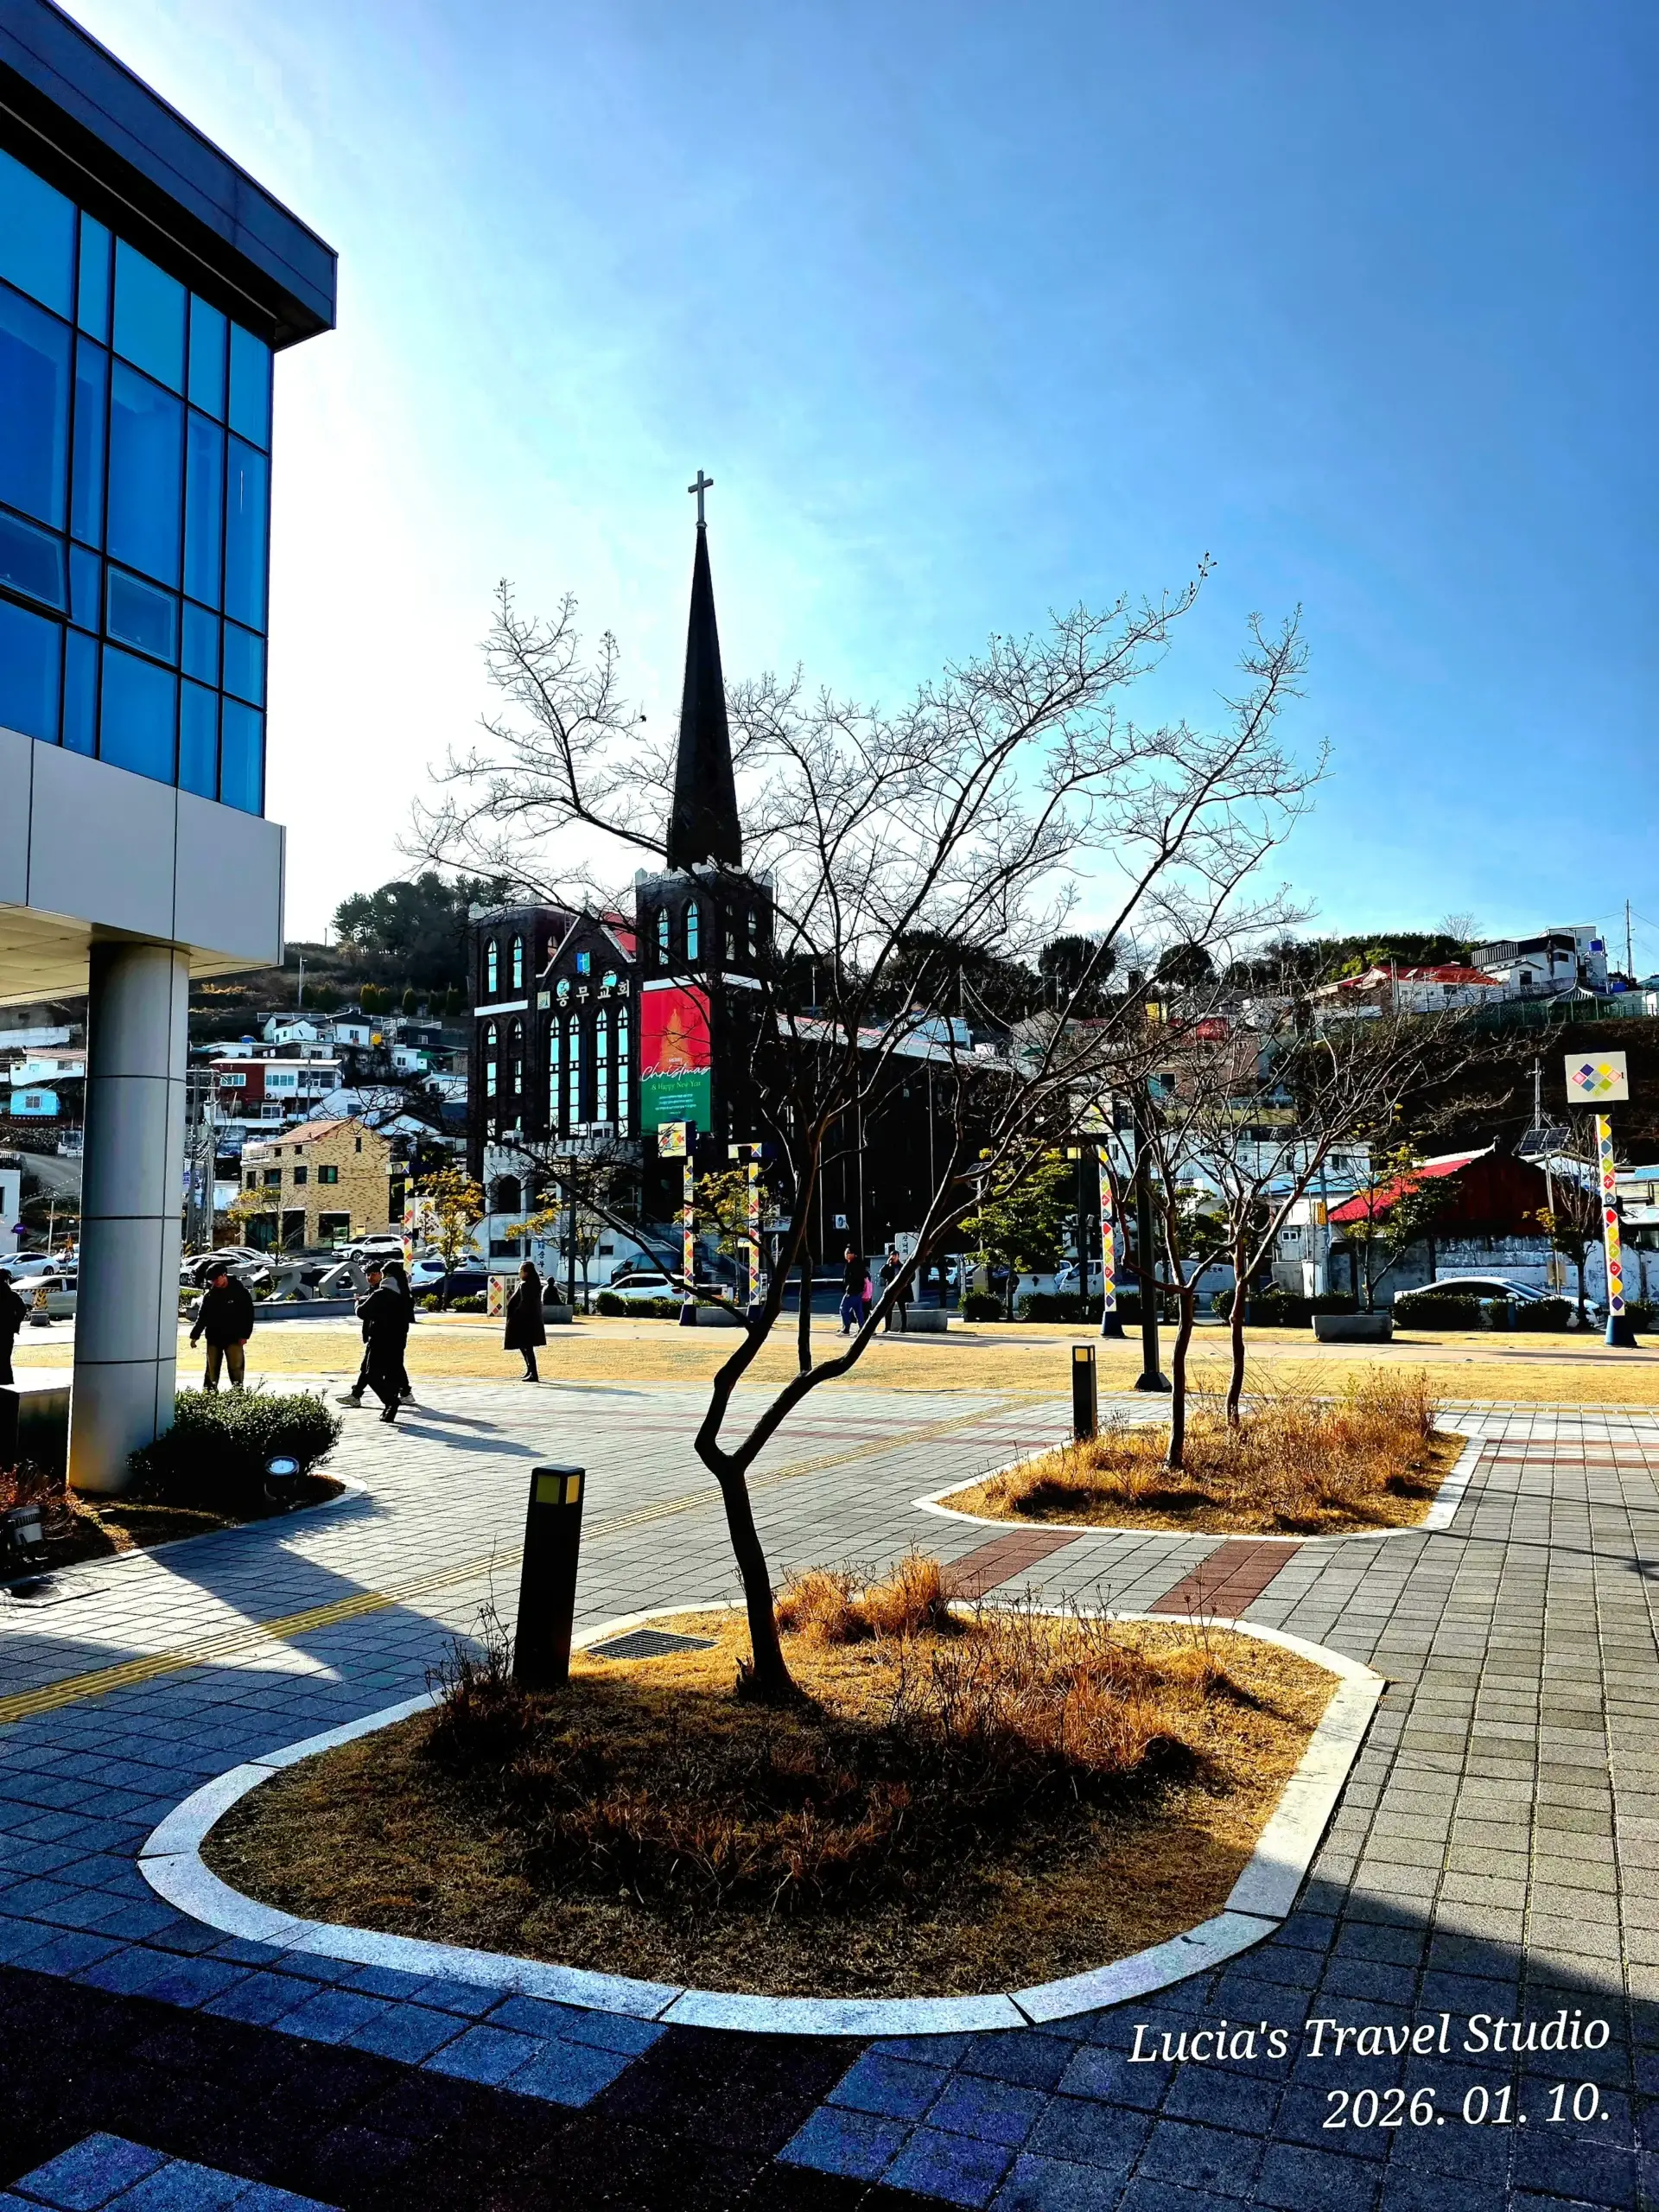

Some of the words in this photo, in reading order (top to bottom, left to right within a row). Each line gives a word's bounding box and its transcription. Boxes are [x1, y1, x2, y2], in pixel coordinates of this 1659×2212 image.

[556, 979, 630, 1007] 충무교회
[641, 1061, 711, 1082] Christmas
[658, 1083, 675, 1091] Happy
